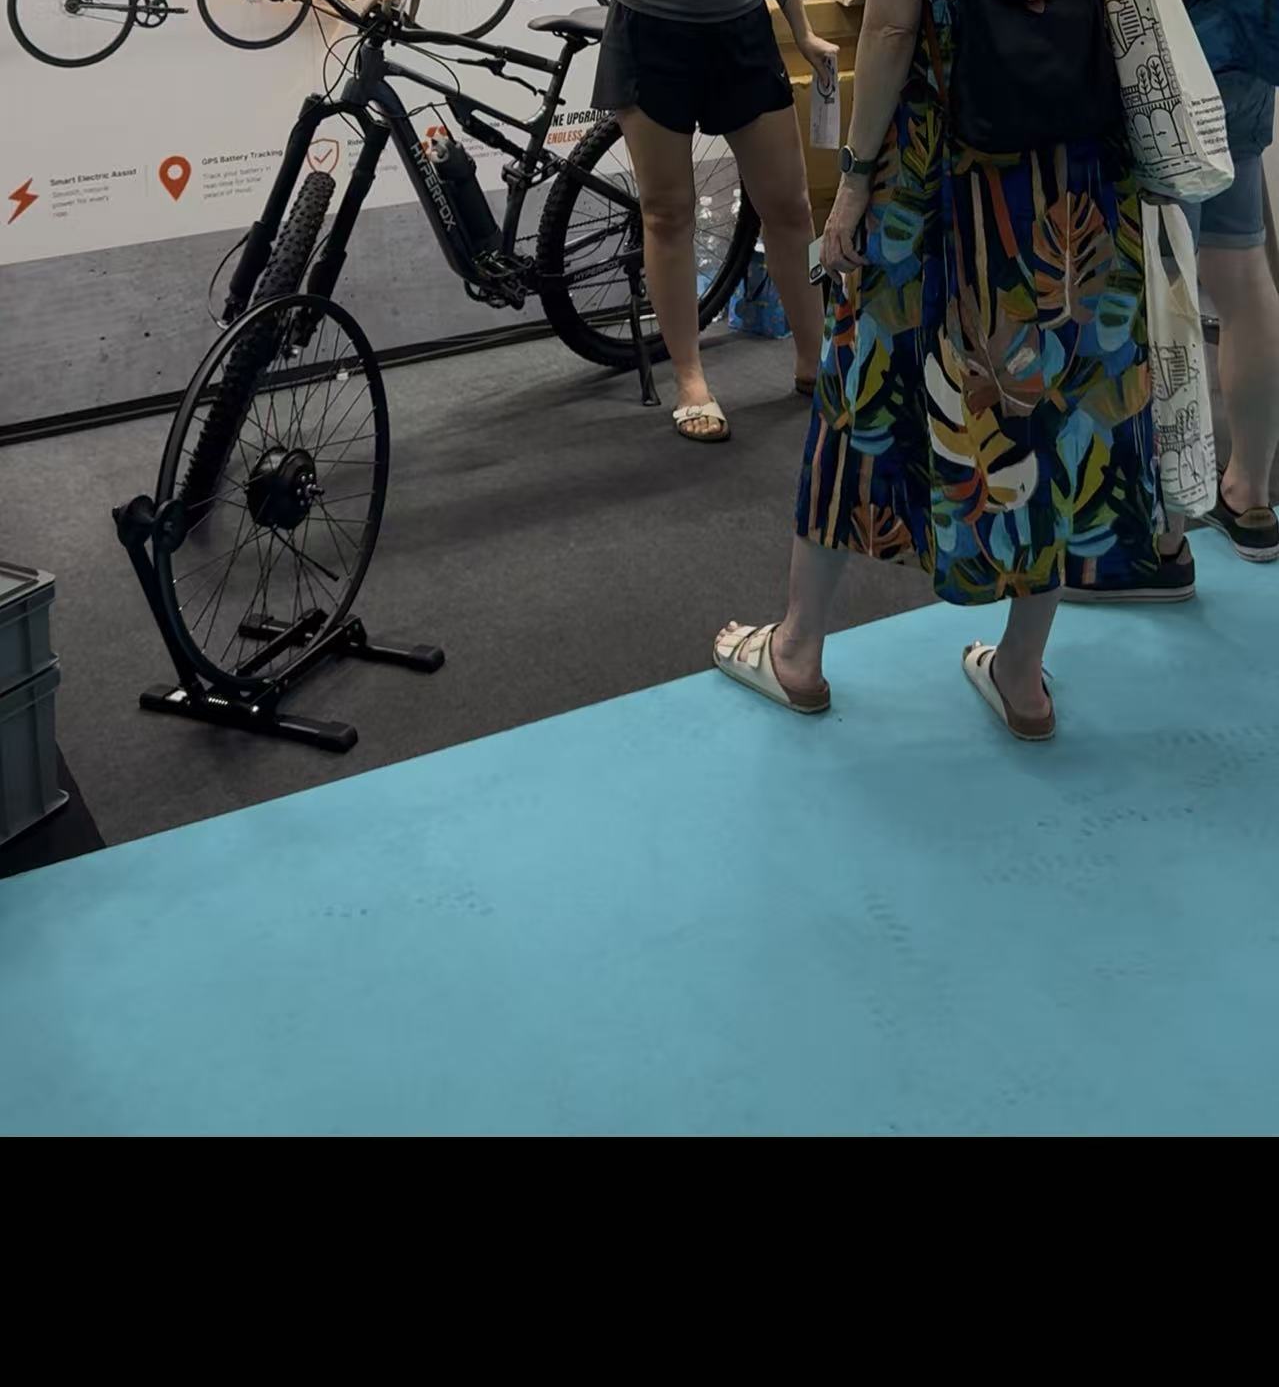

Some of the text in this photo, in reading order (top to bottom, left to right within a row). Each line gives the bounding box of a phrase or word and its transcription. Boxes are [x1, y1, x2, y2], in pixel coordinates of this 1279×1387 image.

[547, 129, 583, 145] ENDLESS
[201, 150, 283, 166] GPS Battery Tracking
[50, 168, 137, 186] Smart Electric Assist
[410, 142, 457, 232] HYPERFOX
